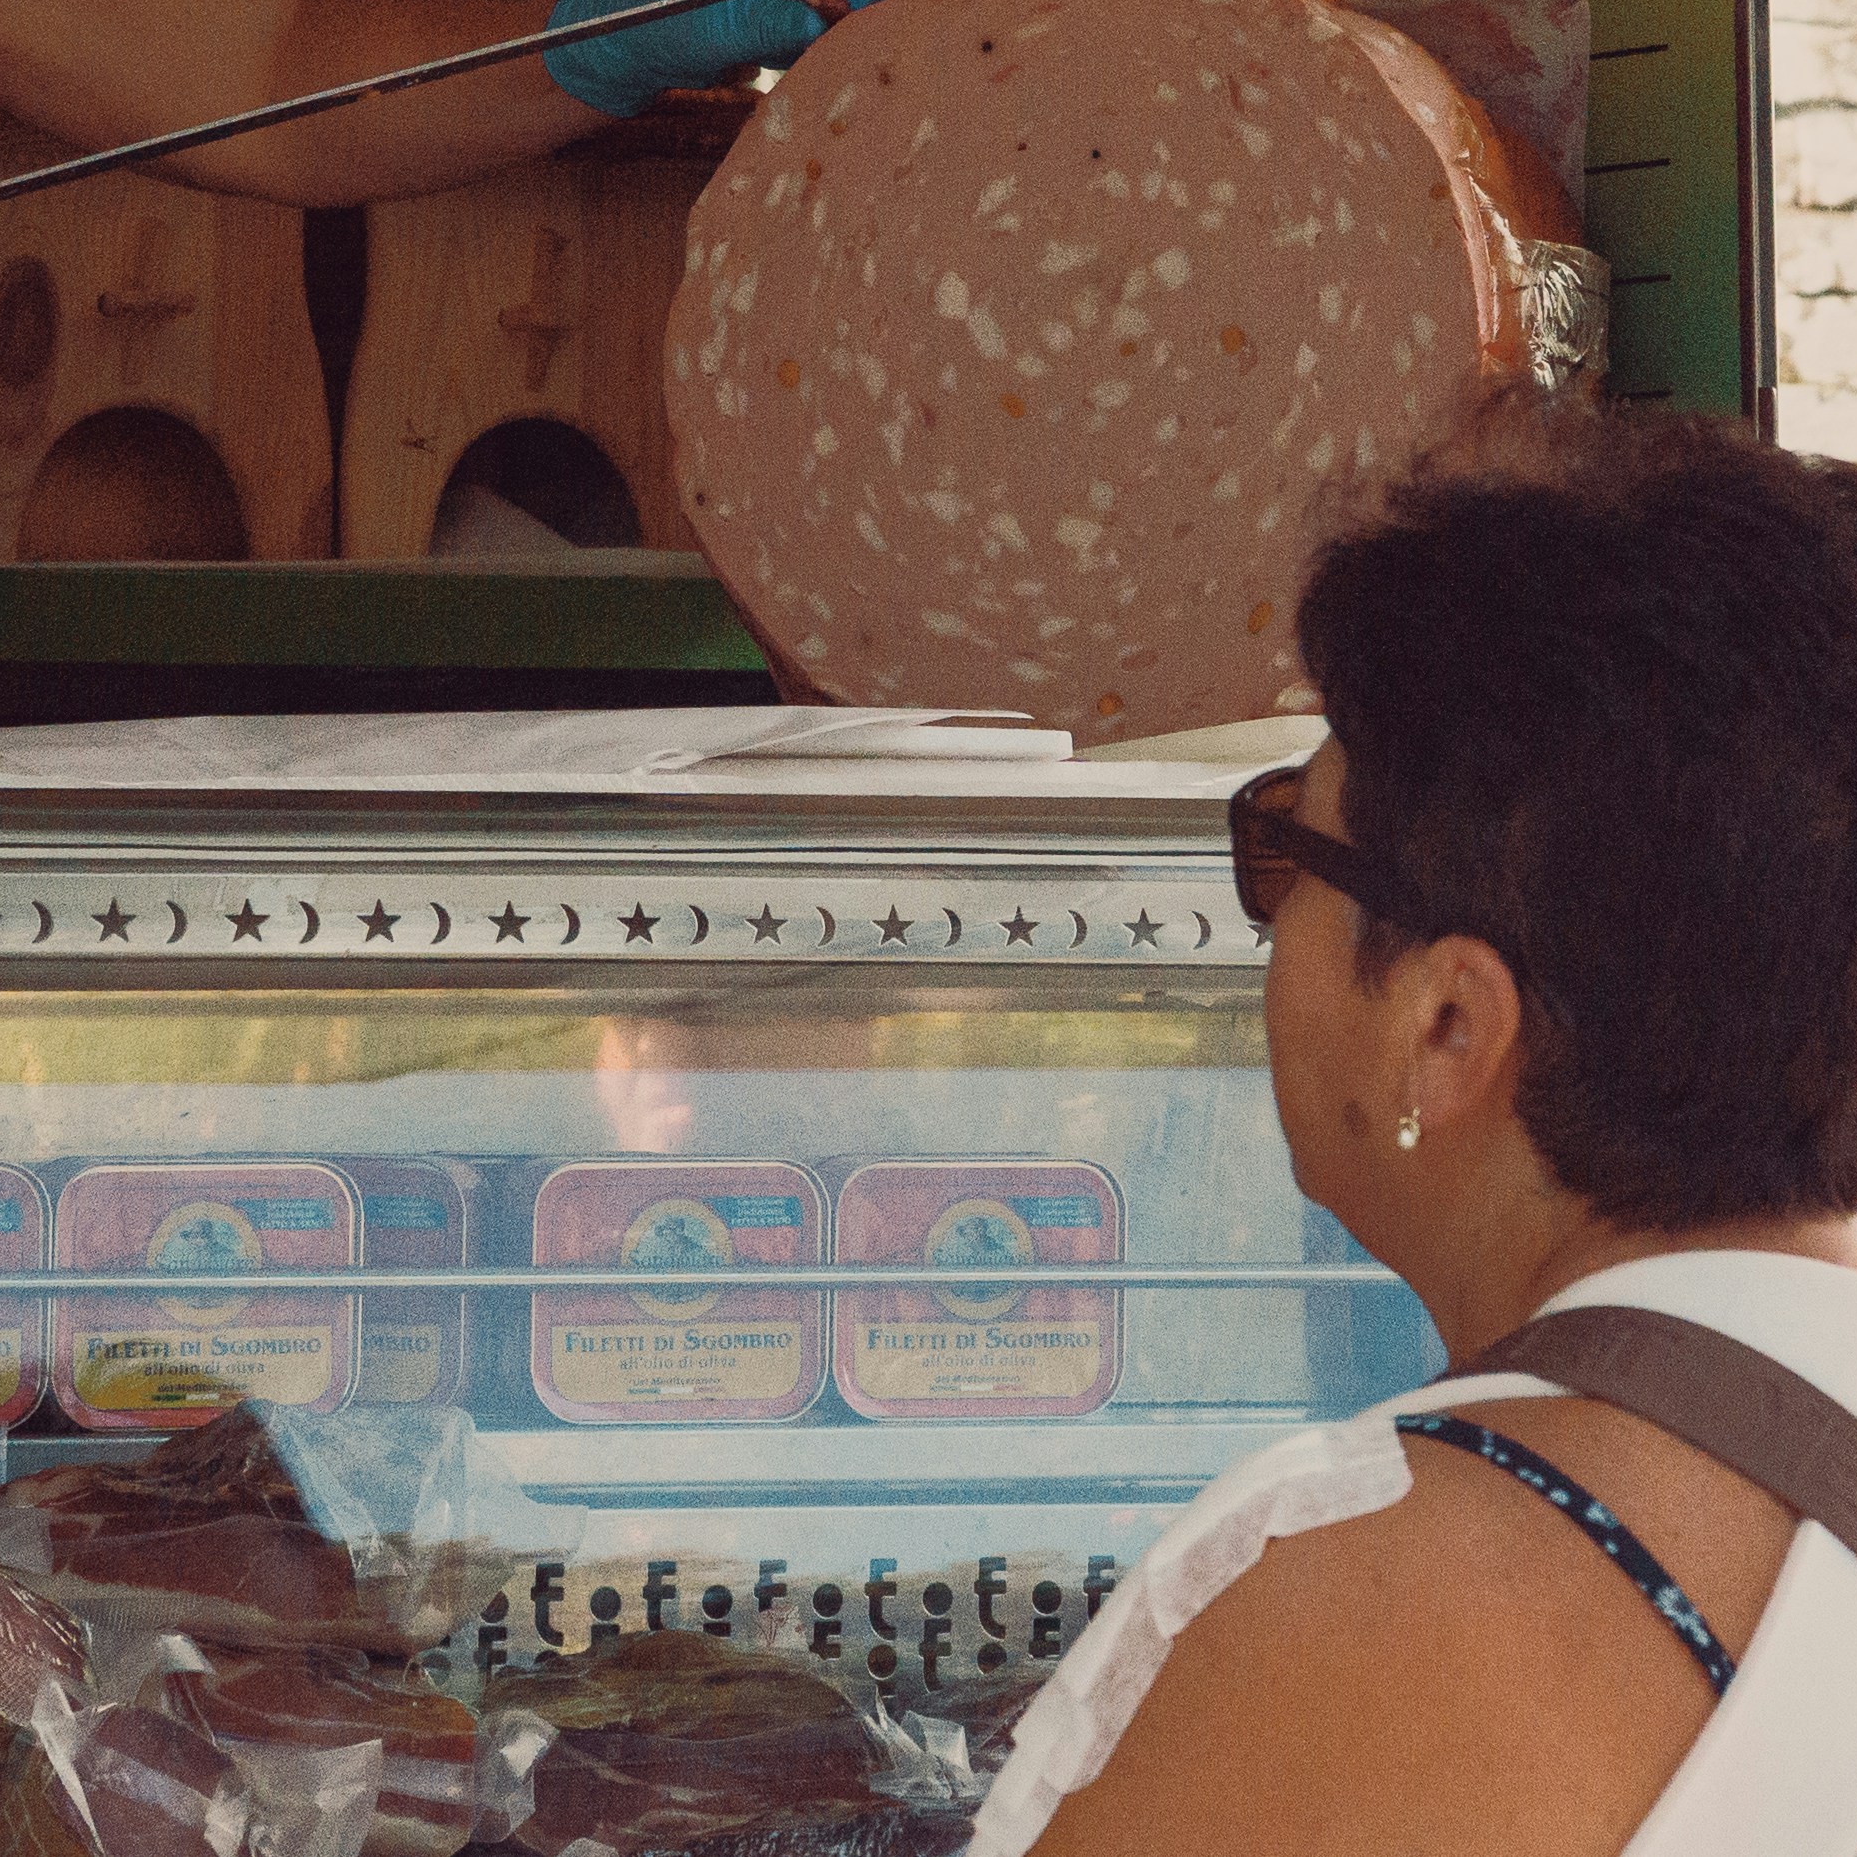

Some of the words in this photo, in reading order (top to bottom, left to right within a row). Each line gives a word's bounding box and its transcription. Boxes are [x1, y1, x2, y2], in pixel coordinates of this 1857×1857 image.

[87, 1338, 170, 1360] FILETTI
[180, 1342, 202, 1356] DI
[210, 1334, 322, 1356] SGOMBRO
[364, 1335, 431, 1354] MBRO
[564, 1331, 645, 1353] FILETTI
[654, 1336, 675, 1350] DI
[683, 1329, 793, 1350] SGOMBRO
[867, 1329, 947, 1351] FILETTI
[955, 1334, 976, 1349] DI
[985, 1327, 1091, 1349] SGOMBRO
[204, 1360, 221, 1375] di
[225, 1360, 265, 1374] oliva
[678, 1355, 694, 1369] di
[699, 1355, 736, 1369] oliva
[979, 1353, 994, 1366] di
[999, 1353, 1036, 1366] oliva
